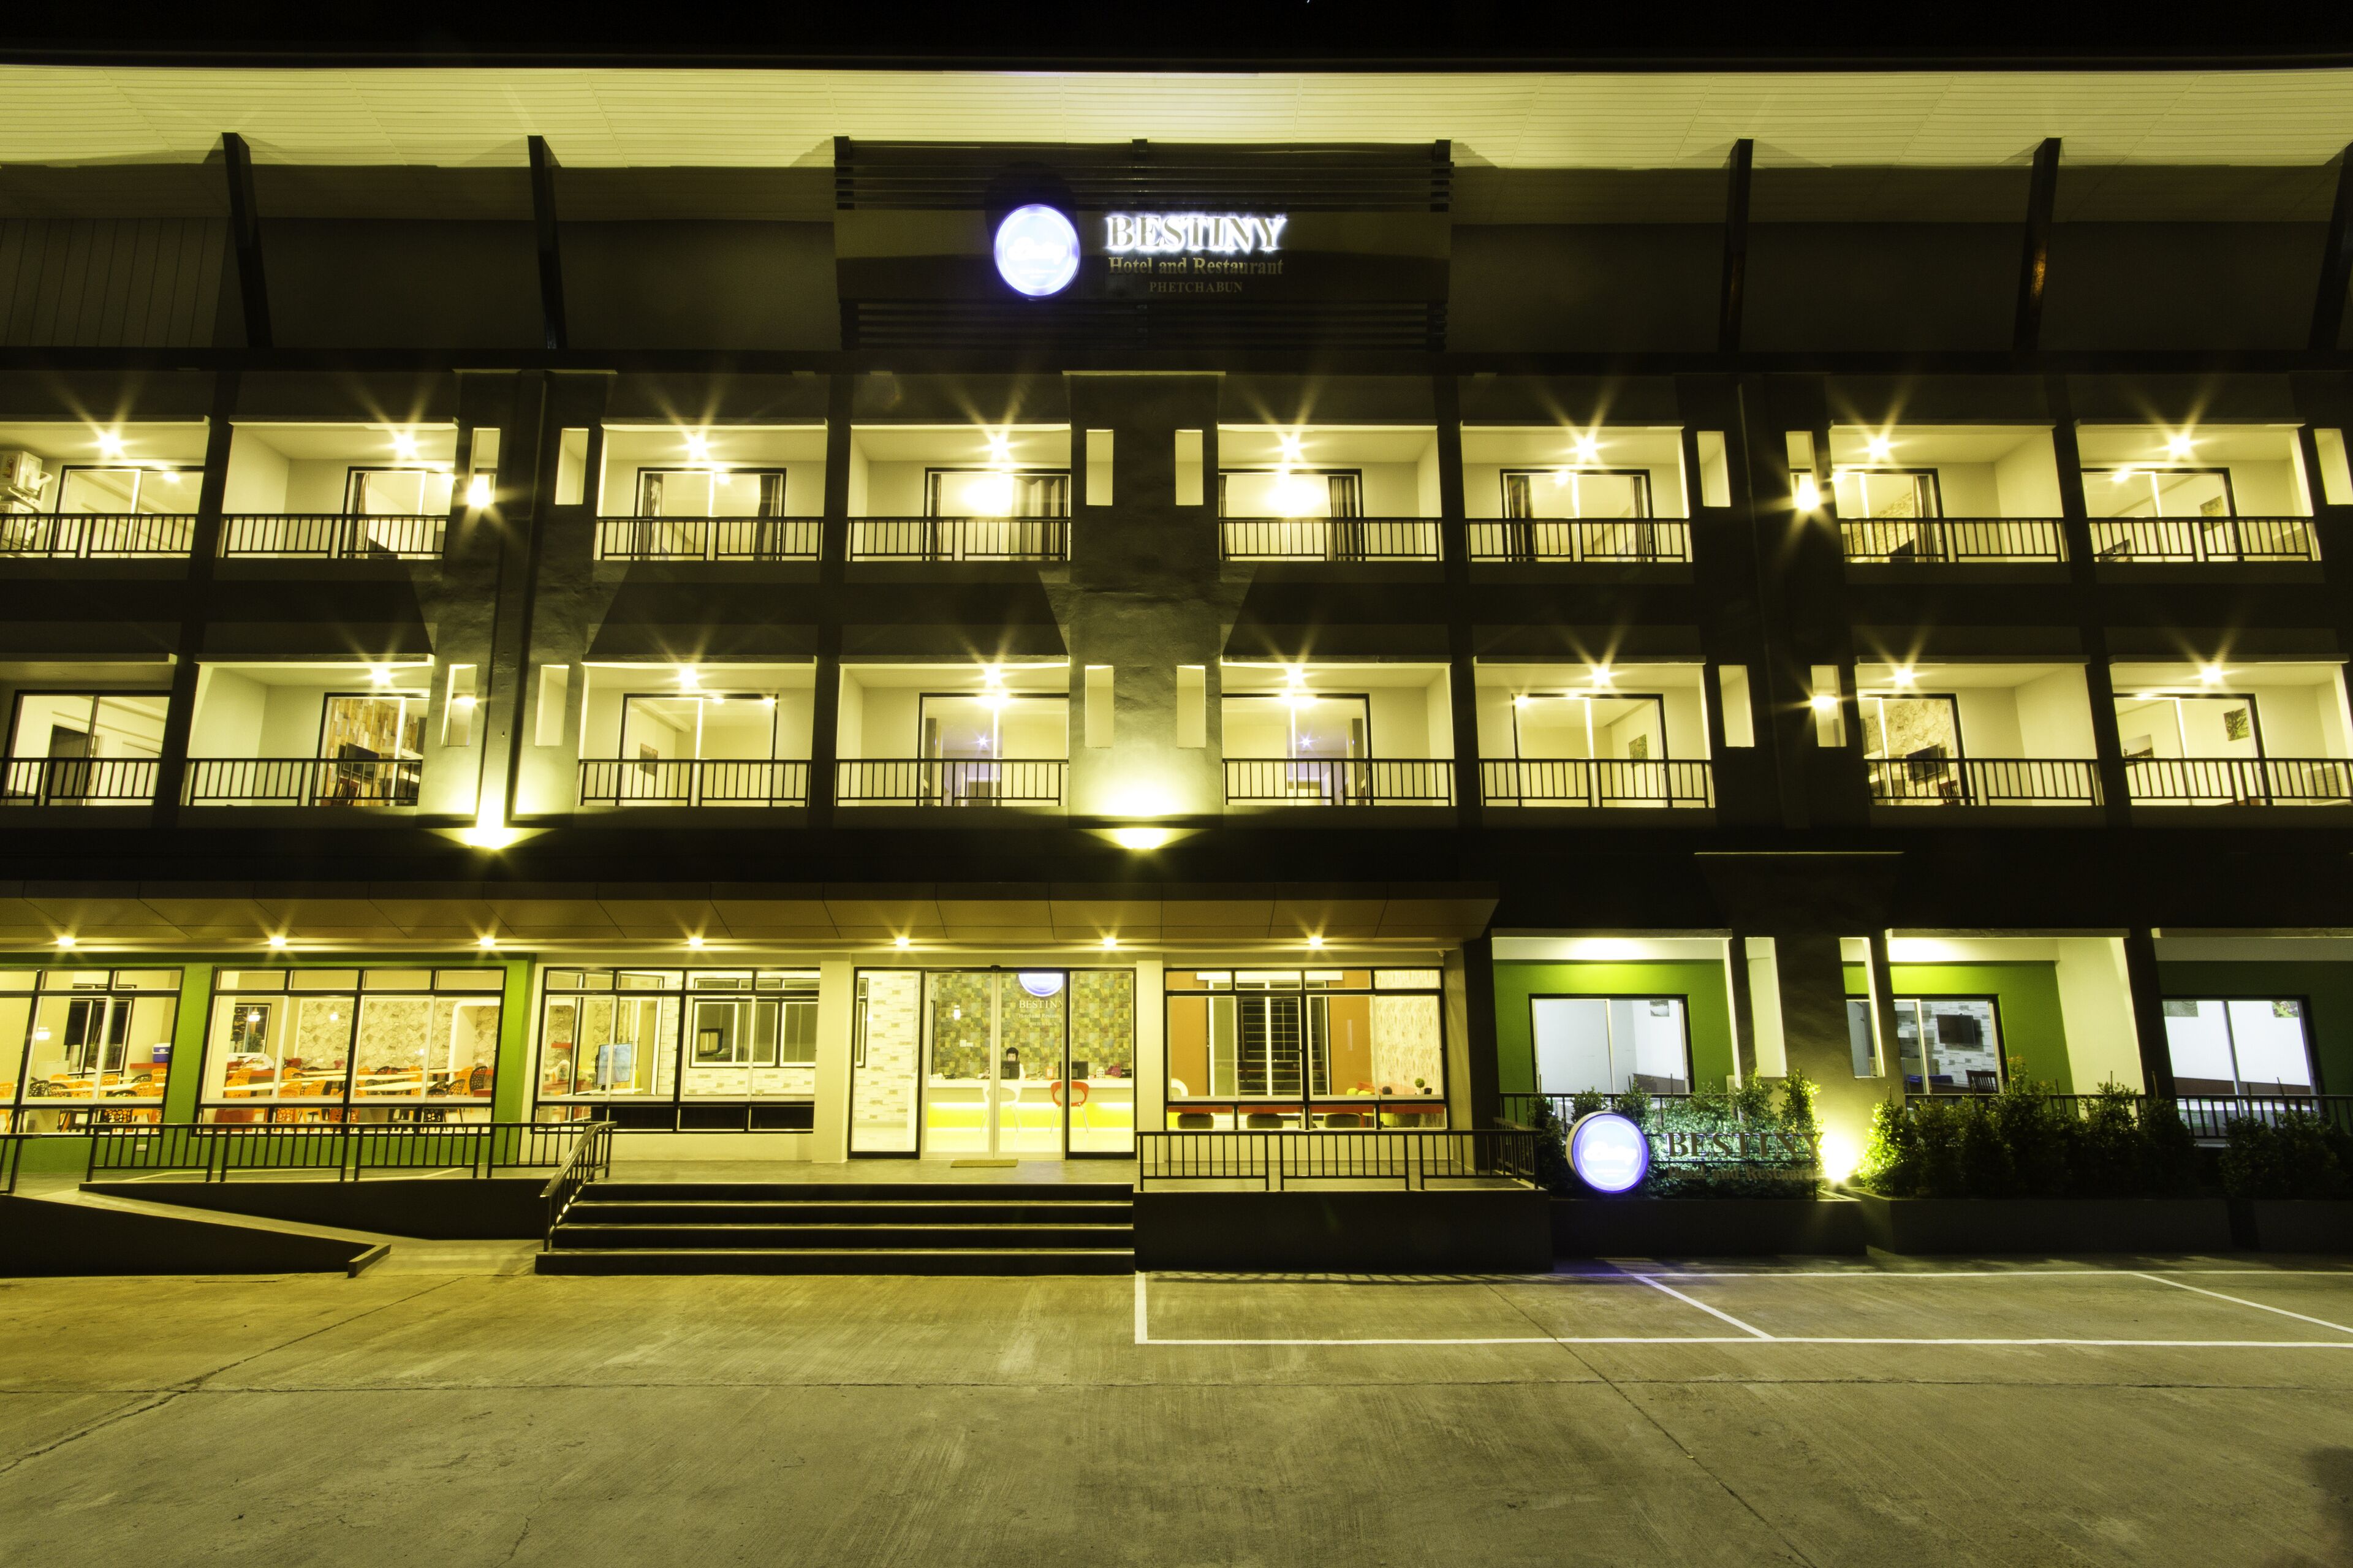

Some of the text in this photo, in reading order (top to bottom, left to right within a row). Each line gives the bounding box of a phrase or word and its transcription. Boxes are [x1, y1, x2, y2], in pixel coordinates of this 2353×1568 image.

[1106, 216, 1287, 250] BESTINY
[1108, 257, 1284, 275] Hotel and Restaurant
[1149, 281, 1243, 293] PHETCHABUN
[1666, 1132, 1825, 1157] BESTINY
